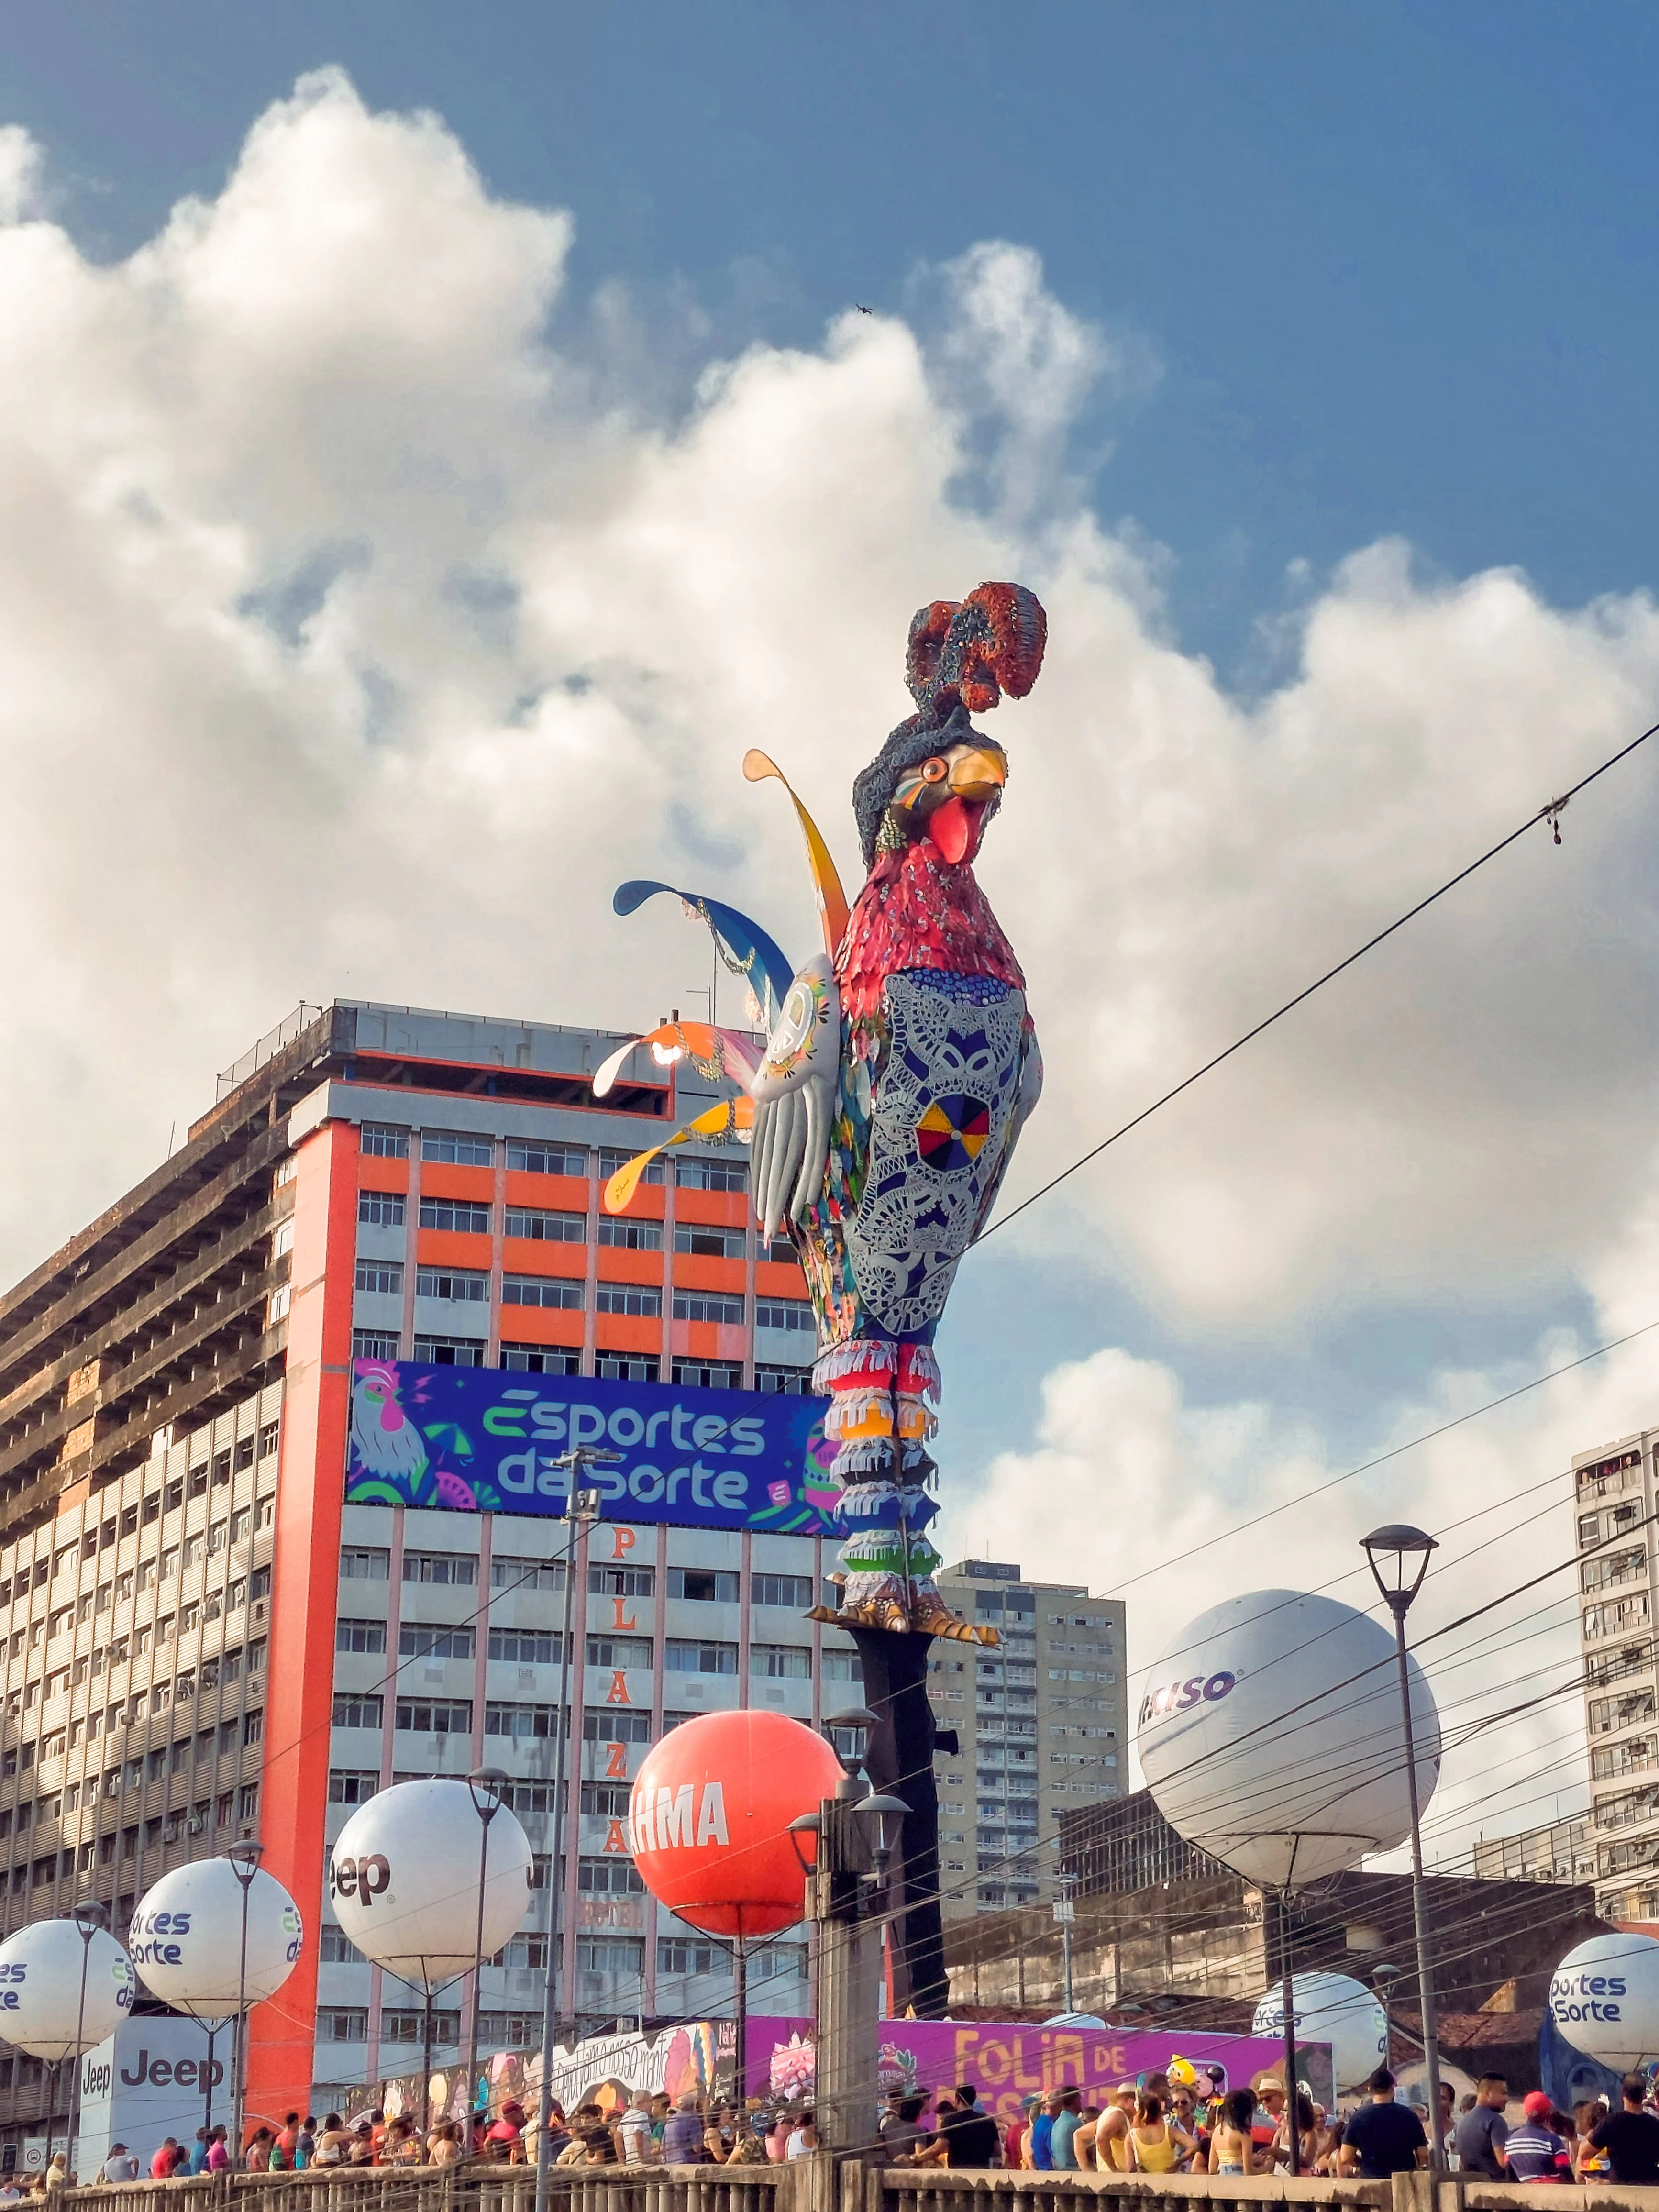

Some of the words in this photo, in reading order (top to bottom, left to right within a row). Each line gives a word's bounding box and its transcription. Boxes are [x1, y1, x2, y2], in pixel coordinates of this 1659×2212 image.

[483, 1389, 765, 1456] Esportes
[83, 2059, 110, 2098] Jeep
[120, 2049, 224, 2094] Jeep
[1095, 2046, 1127, 2074] DE
